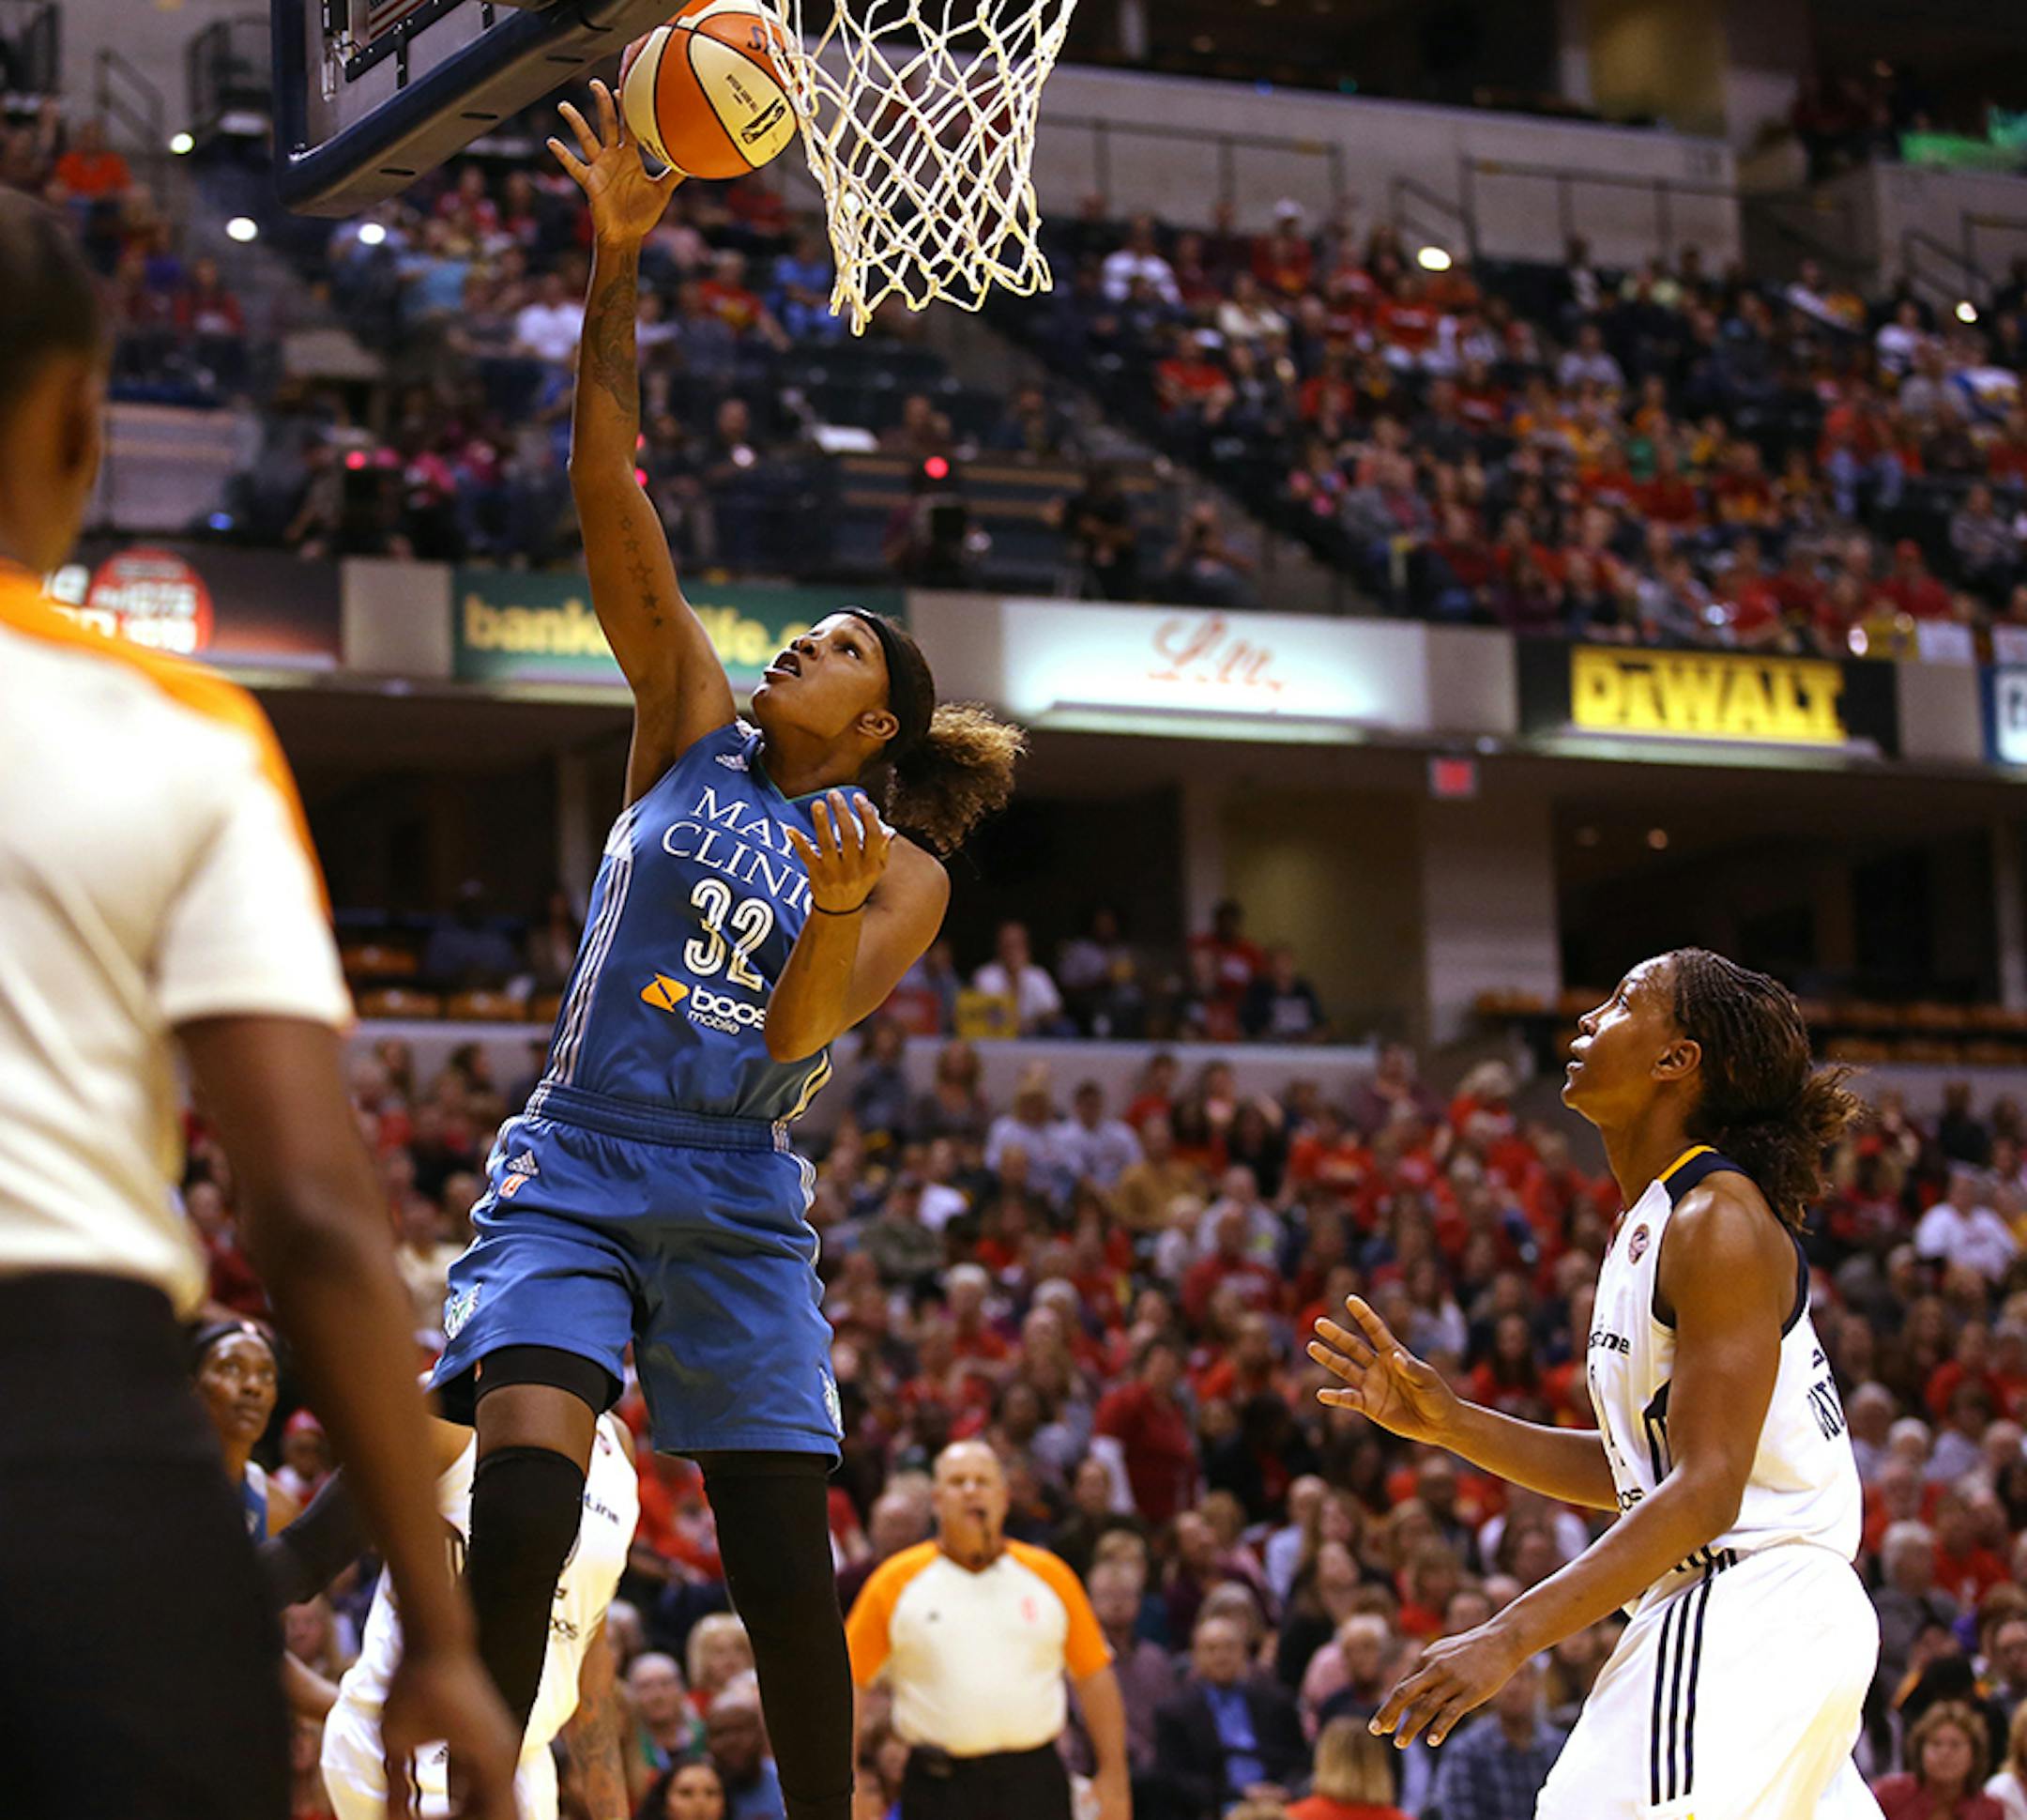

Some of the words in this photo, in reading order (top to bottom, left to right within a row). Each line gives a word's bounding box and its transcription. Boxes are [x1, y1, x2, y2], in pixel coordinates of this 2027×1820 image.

[690, 786, 823, 858] MAY
[662, 821, 813, 916] CLINI
[683, 878, 774, 992] 32
[691, 985, 766, 1032] boos
